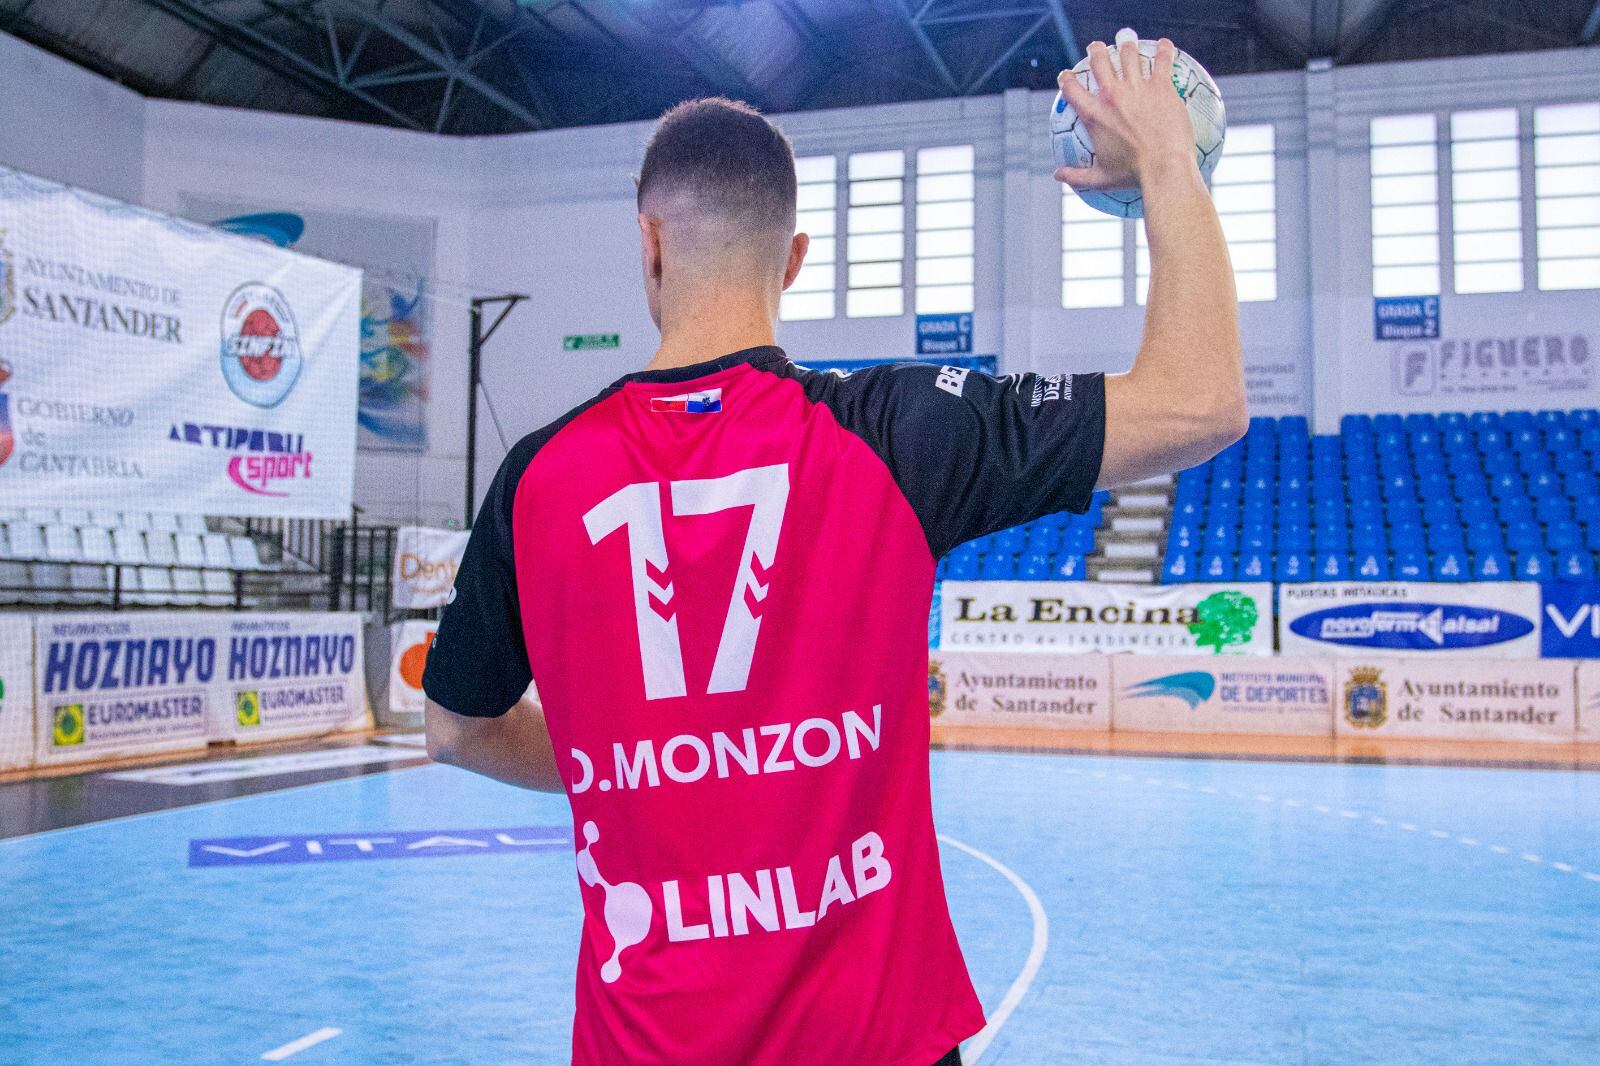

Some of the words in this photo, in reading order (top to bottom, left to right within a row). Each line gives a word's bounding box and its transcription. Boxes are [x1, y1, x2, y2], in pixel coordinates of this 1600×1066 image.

[23, 257, 159, 301] AYUNTAMIENTO
[23, 288, 182, 343] SANTANDER
[17, 399, 135, 428] GOBIERNO
[19, 451, 143, 478] CANTABRIA
[247, 452, 312, 487] sport
[582, 463, 790, 701] 17
[955, 598, 1018, 622] La
[1028, 598, 1203, 625] Encina
[950, 633, 1024, 645] CENTRO
[44, 637, 216, 693] HOZNAYO
[228, 634, 355, 681] HOZNAYO
[956, 671, 1098, 693] Ayuntamiento
[1221, 686, 1240, 701] DE
[1245, 686, 1328, 703] DEPORTES
[1399, 678, 1559, 701] Ayuntamiento
[88, 697, 203, 725] EUROMASTER
[262, 686, 343, 710] EUROMASTER
[955, 694, 977, 711] de
[992, 695, 1098, 715] Santander
[1398, 703, 1424, 722] de
[1440, 705, 1560, 725] Santander
[661, 831, 893, 943] LINLAB
